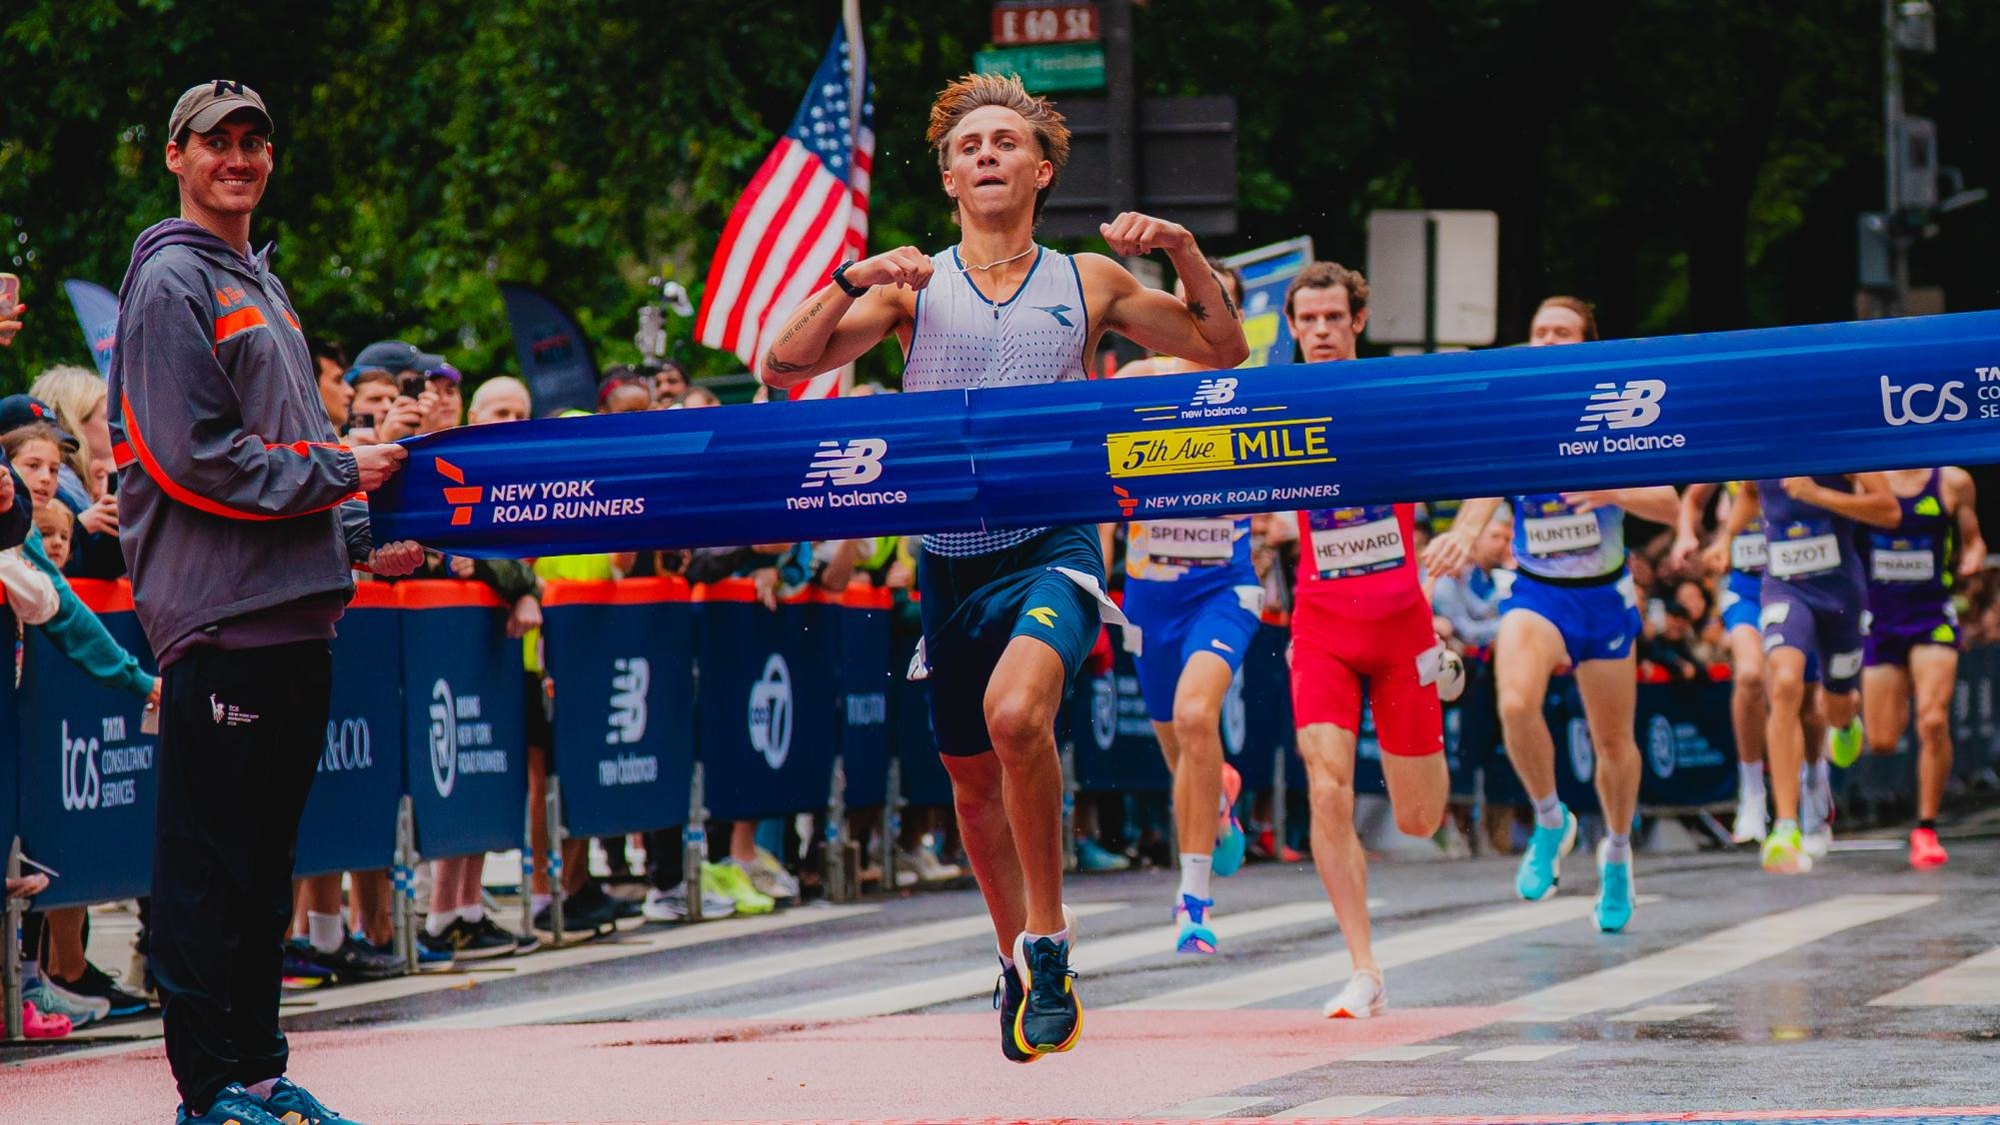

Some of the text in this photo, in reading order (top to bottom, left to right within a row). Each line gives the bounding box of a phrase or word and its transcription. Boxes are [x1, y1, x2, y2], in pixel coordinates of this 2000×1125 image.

[1002, 11, 1018, 41] E
[1025, 10, 1058, 40] 60
[1181, 406, 1248, 420] new balance
[1880, 375, 1968, 426] tcs
[1122, 439, 1168, 470] 5th
[1238, 426, 1329, 461] MILE
[1559, 434, 1686, 456] new balance
[490, 479, 596, 502] NEW YORK
[786, 490, 907, 510] new balance
[1145, 484, 1341, 509] NEW YORK ROAD RUNNERS
[492, 498, 645, 523] ROAD RUNNERS
[1151, 527, 1231, 542] SPENCER
[1316, 532, 1400, 558] HEYWARD
[1528, 524, 1597, 542] HUNTER
[1782, 545, 1827, 563] SZOT
[102, 715, 126, 742] TATA
[62, 719, 100, 811] tcs
[102, 744, 154, 775] CONSULTANCY
[599, 752, 658, 786] new balance
[102, 779, 136, 808] SERVICES
